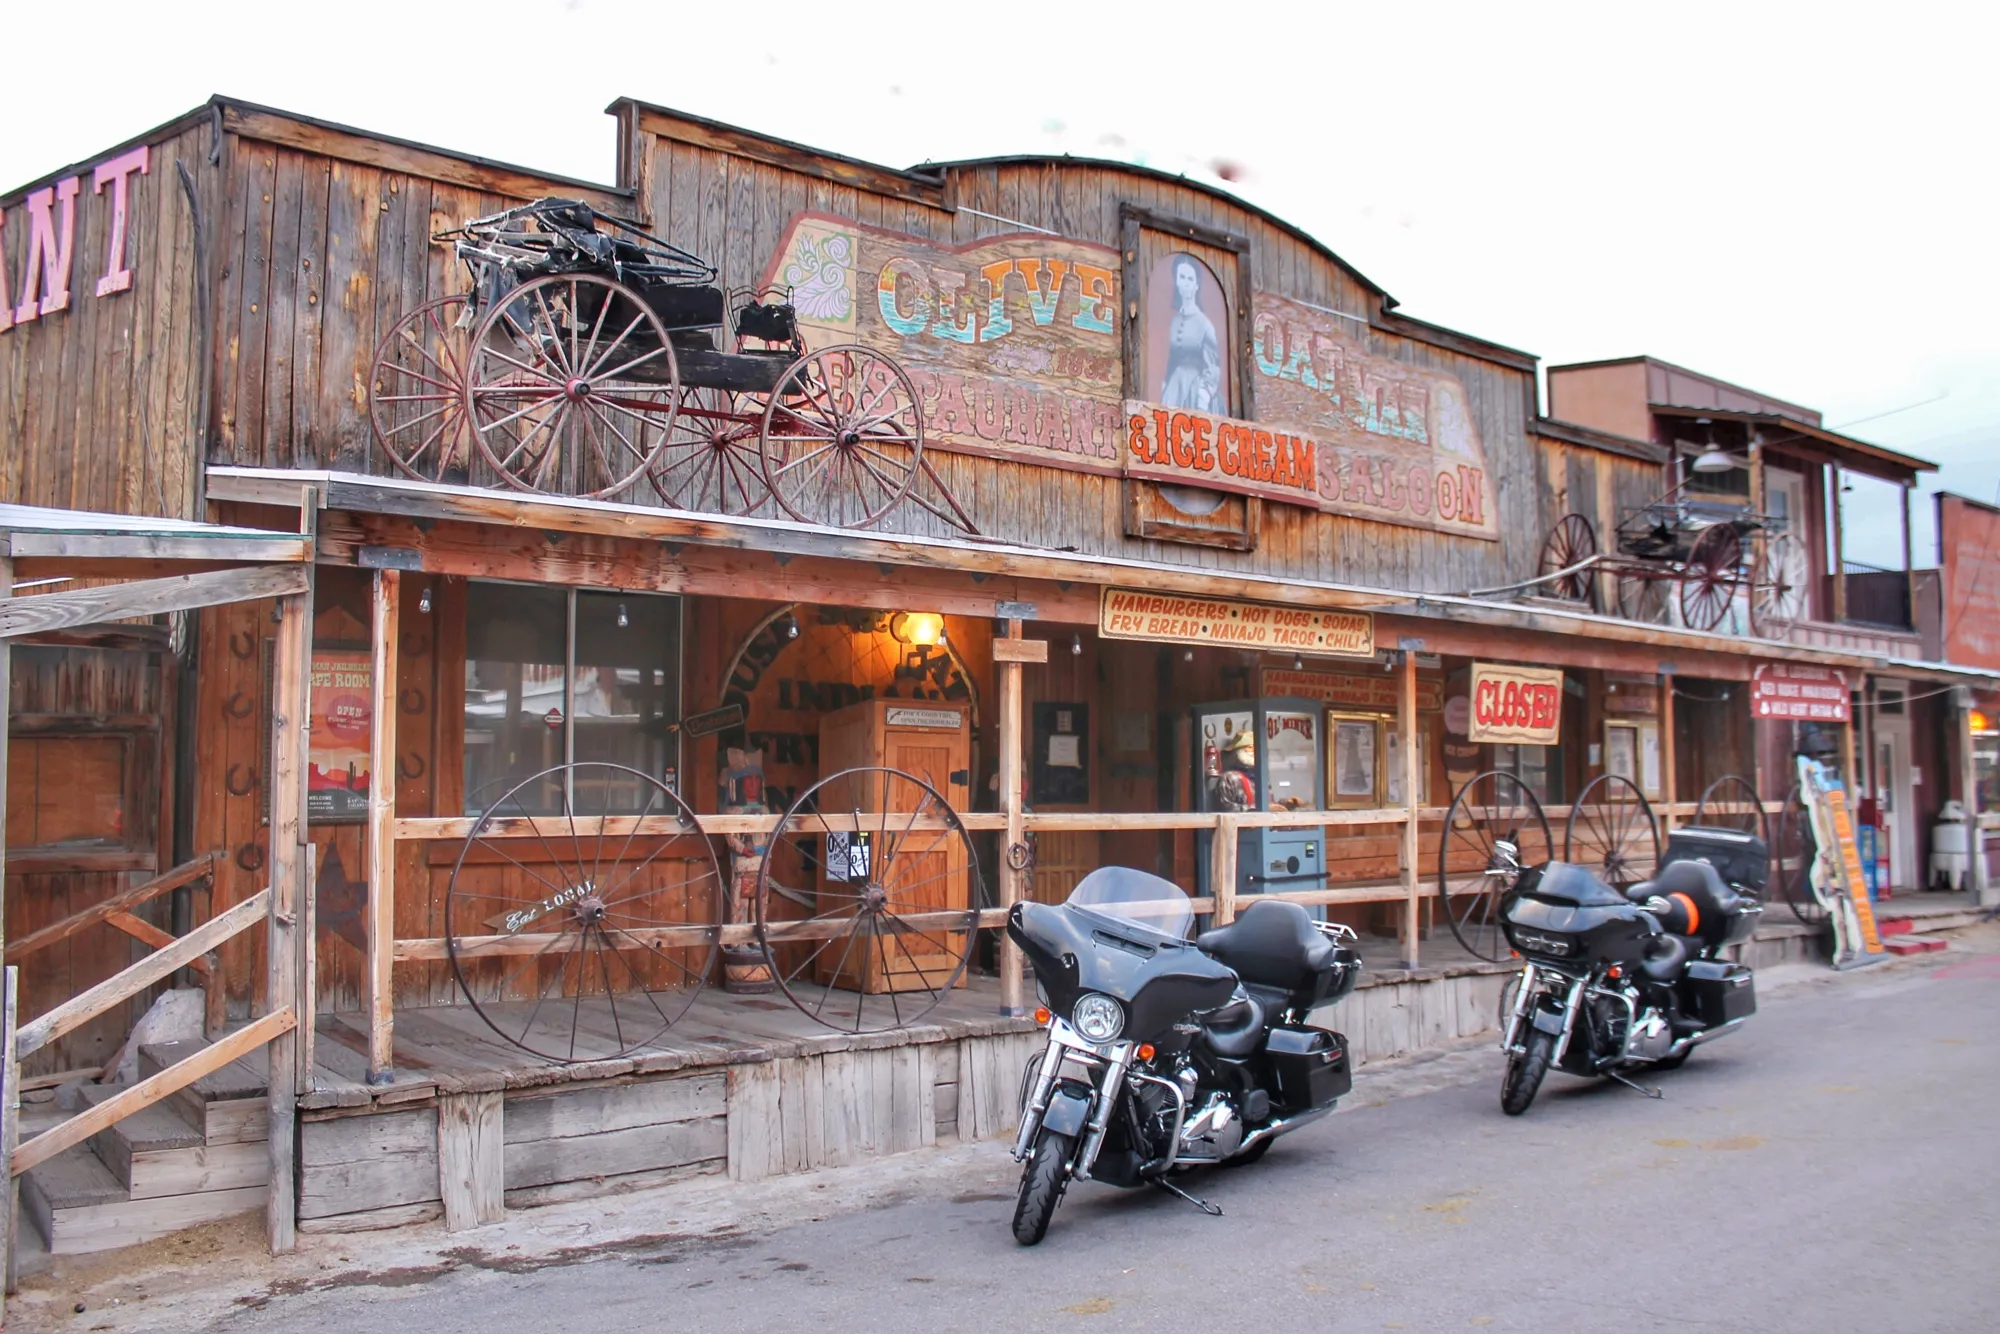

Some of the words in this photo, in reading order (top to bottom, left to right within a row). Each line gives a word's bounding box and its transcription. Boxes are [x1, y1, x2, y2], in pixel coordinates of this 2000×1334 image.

[878, 256, 1114, 345] OLIVE
[1130, 415, 1153, 464] &
[1153, 409, 1215, 471] ICE
[1217, 423, 1316, 491] CREAM
[1318, 446, 1484, 525] SALOON
[1110, 614, 1144, 632] FRY
[1147, 618, 1201, 638] BREAD
[1210, 622, 1266, 642] NAVAJO
[1272, 628, 1316, 646] TACOS
[1325, 632, 1360, 650] CHILI
[1111, 594, 1228, 621] HAMBURGERS
[1241, 607, 1270, 624] HOT
[1273, 610, 1311, 628] DOGS
[1322, 614, 1365, 632] SODAS
[335, 673, 371, 688] ROOM
[1475, 679, 1558, 729] CLOSED
[506, 908, 537, 932] Eat
